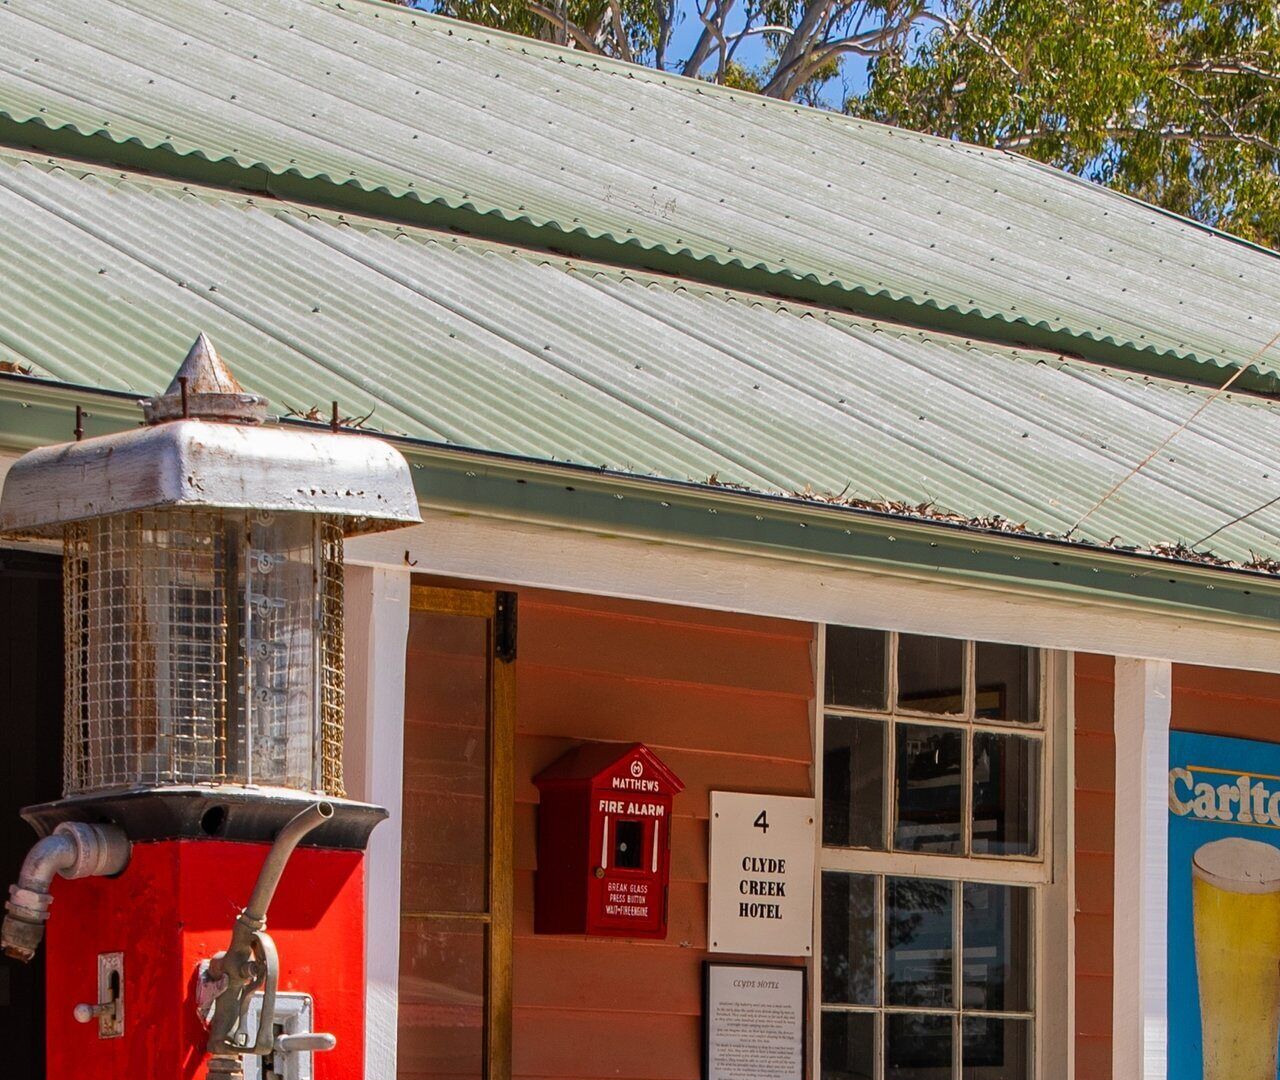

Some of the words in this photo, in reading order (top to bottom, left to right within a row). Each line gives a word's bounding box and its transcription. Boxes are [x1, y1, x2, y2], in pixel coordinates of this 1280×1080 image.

[612, 777, 659, 792] MATTHEWS
[599, 800, 625, 813] FIRE
[627, 802, 665, 816] ALARM
[753, 810, 770, 834] 4
[742, 856, 786, 874] CLYDE
[608, 882, 628, 892] BREAK
[630, 884, 648, 893] GLASS
[739, 879, 786, 897] CREEK
[610, 893, 626, 903] PRESS
[739, 902, 783, 919] HOTEL
